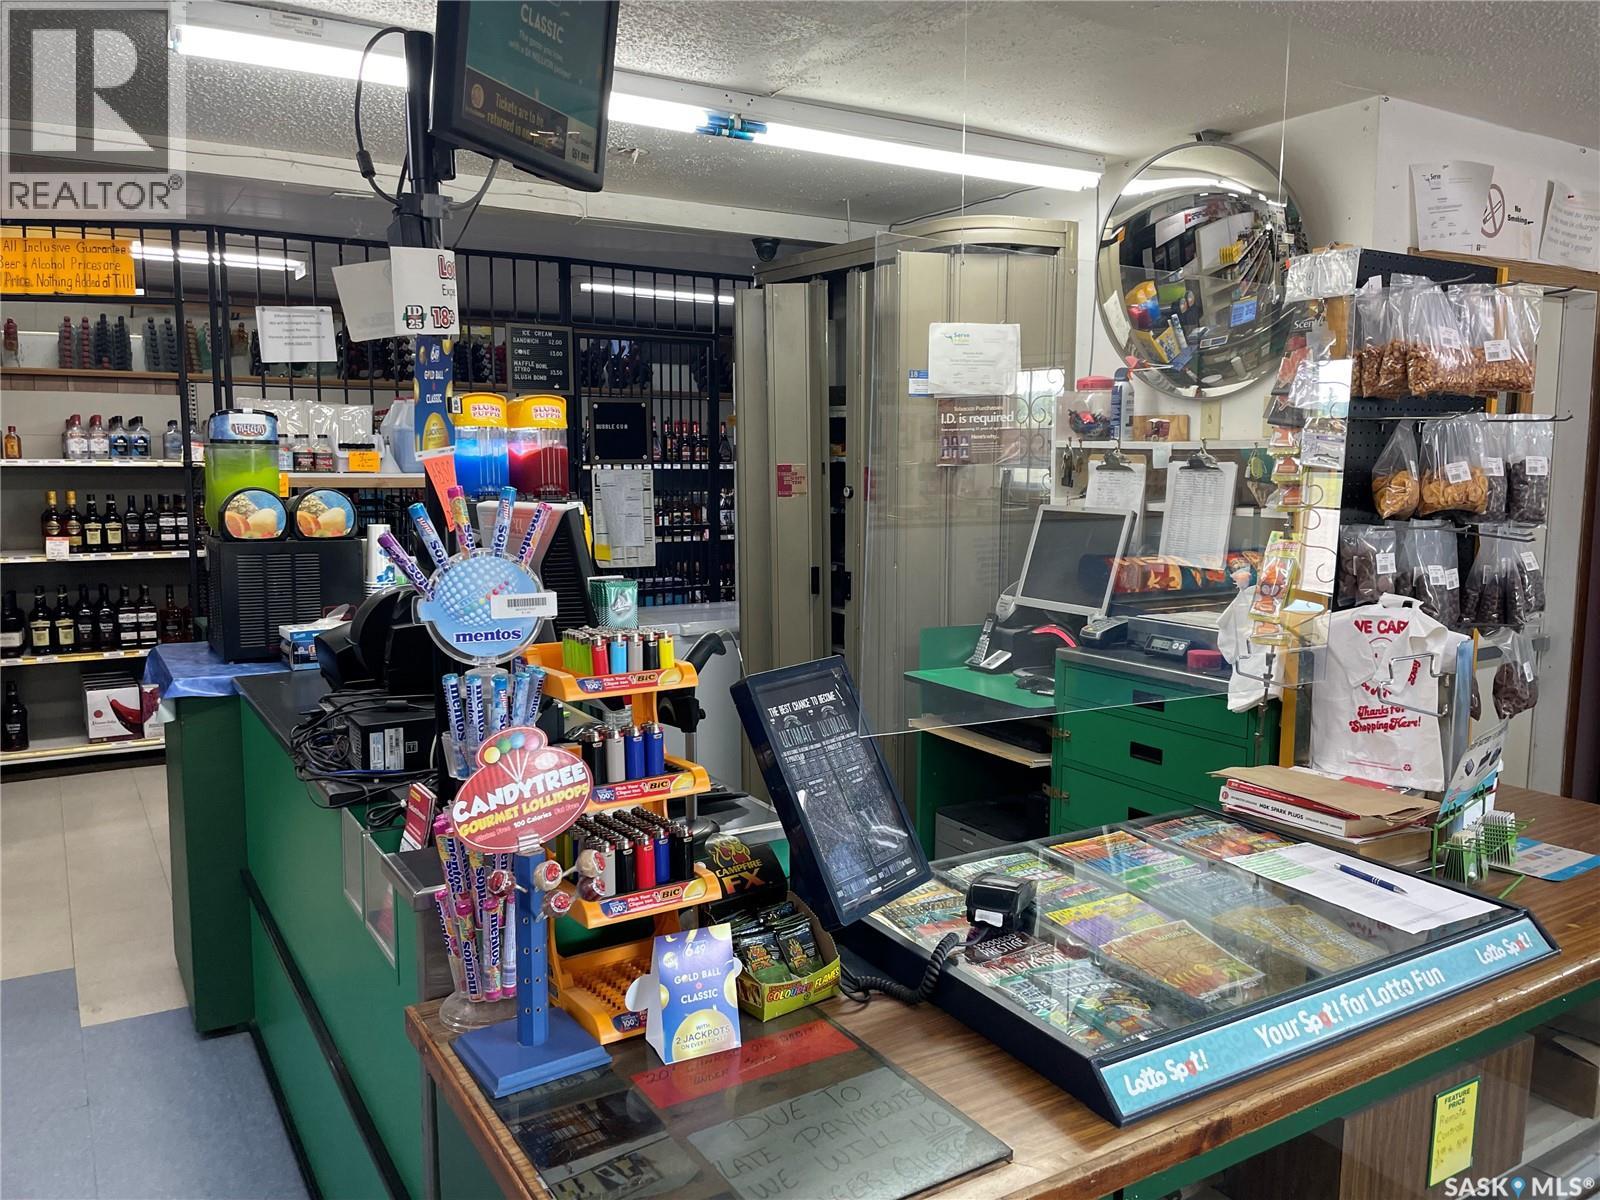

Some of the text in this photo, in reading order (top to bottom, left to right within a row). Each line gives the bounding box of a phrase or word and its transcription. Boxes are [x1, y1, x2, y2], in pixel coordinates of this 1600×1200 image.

[520, 4, 565, 44] CLASSIC
[1514, 205, 1522, 214] No
[1507, 214, 1528, 225] Smoking
[3, 239, 17, 252] All
[23, 240, 71, 254] Inclusive
[30, 256, 66, 270] Alcohol
[36, 273, 73, 291] Nothing
[74, 273, 100, 288] Added
[102, 273, 114, 288] at
[407, 306, 423, 317] ID
[431, 306, 455, 329] 18+
[408, 318, 423, 330] 25
[512, 336, 539, 345] SANDWICH
[522, 330, 531, 338] ICE
[535, 362, 549, 370] BOWL
[532, 406, 561, 414] SLUSH
[940, 411, 1014, 427] I.D. is required
[455, 629, 523, 644] mentos
[450, 683, 466, 742] mentos
[768, 691, 836, 718] THE BEST CHANCE TO BECOME
[1357, 705, 1389, 719] Thanks
[816, 713, 852, 738] ULTIMATE
[1349, 716, 1421, 734] Shopping Here!
[779, 724, 817, 748] ULTIMATE
[452, 762, 586, 823] CANDYTREE
[458, 804, 520, 838] GOURMET
[521, 782, 590, 817] LOLLIPOPS
[1270, 805, 1287, 816] SPARK
[1287, 810, 1304, 820] PLUGS
[513, 811, 553, 829] 100 Calories
[715, 857, 763, 878] CAMPFIRE
[722, 868, 766, 895] FX
[490, 912, 501, 967] mentos
[980, 937, 1028, 958] PRESTIGE
[1475, 931, 1533, 965] Lotto Spot!
[463, 941, 477, 995] mentos
[674, 967, 722, 985] GOLD BALL
[814, 966, 840, 987] FLAMES
[680, 988, 718, 1004] CLASSIC
[1253, 966, 1446, 1049] Your Spot! for Lotto Fun
[675, 1024, 731, 1046] 2 JACKPOTS
[695, 1022, 711, 1031] WITH
[1123, 1048, 1209, 1097] Lotto Spot!
[1444, 1087, 1471, 1105] FEATURE
[1447, 1098, 1466, 1111] PRICE
[728, 1085, 862, 1141] DUE TO
[714, 1087, 928, 1180] LATE PAYMENTS
[748, 1108, 952, 1200] WE WILL NO
